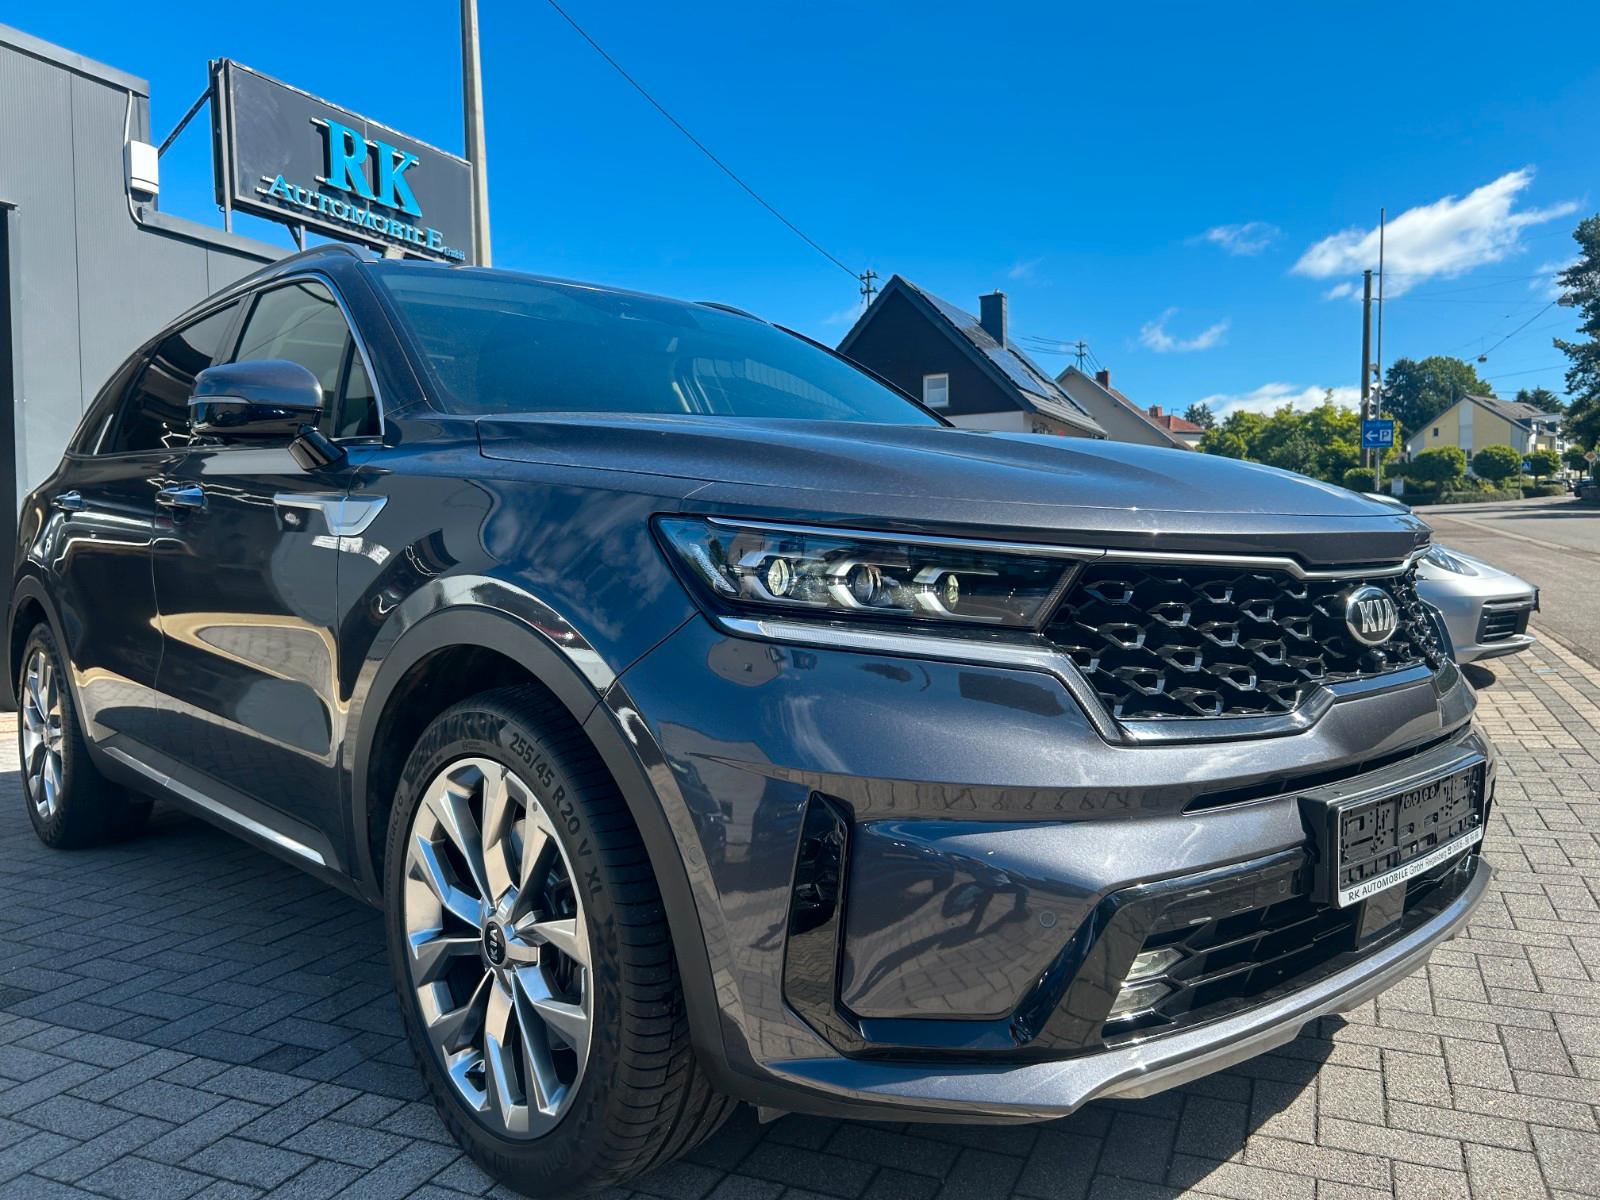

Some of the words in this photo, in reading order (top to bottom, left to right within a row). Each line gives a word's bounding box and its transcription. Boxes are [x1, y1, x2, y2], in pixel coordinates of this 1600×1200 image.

[311, 117, 422, 217] RK
[256, 174, 444, 253] AUTOMOBILE
[1358, 598, 1395, 633] KIA
[510, 732, 555, 788] 255/45
[578, 838, 593, 857] V
[585, 866, 603, 898] XL
[1348, 889, 1360, 902] RK
[1362, 868, 1408, 896] AUTOMOBILE
[490, 929, 498, 961] KIA
